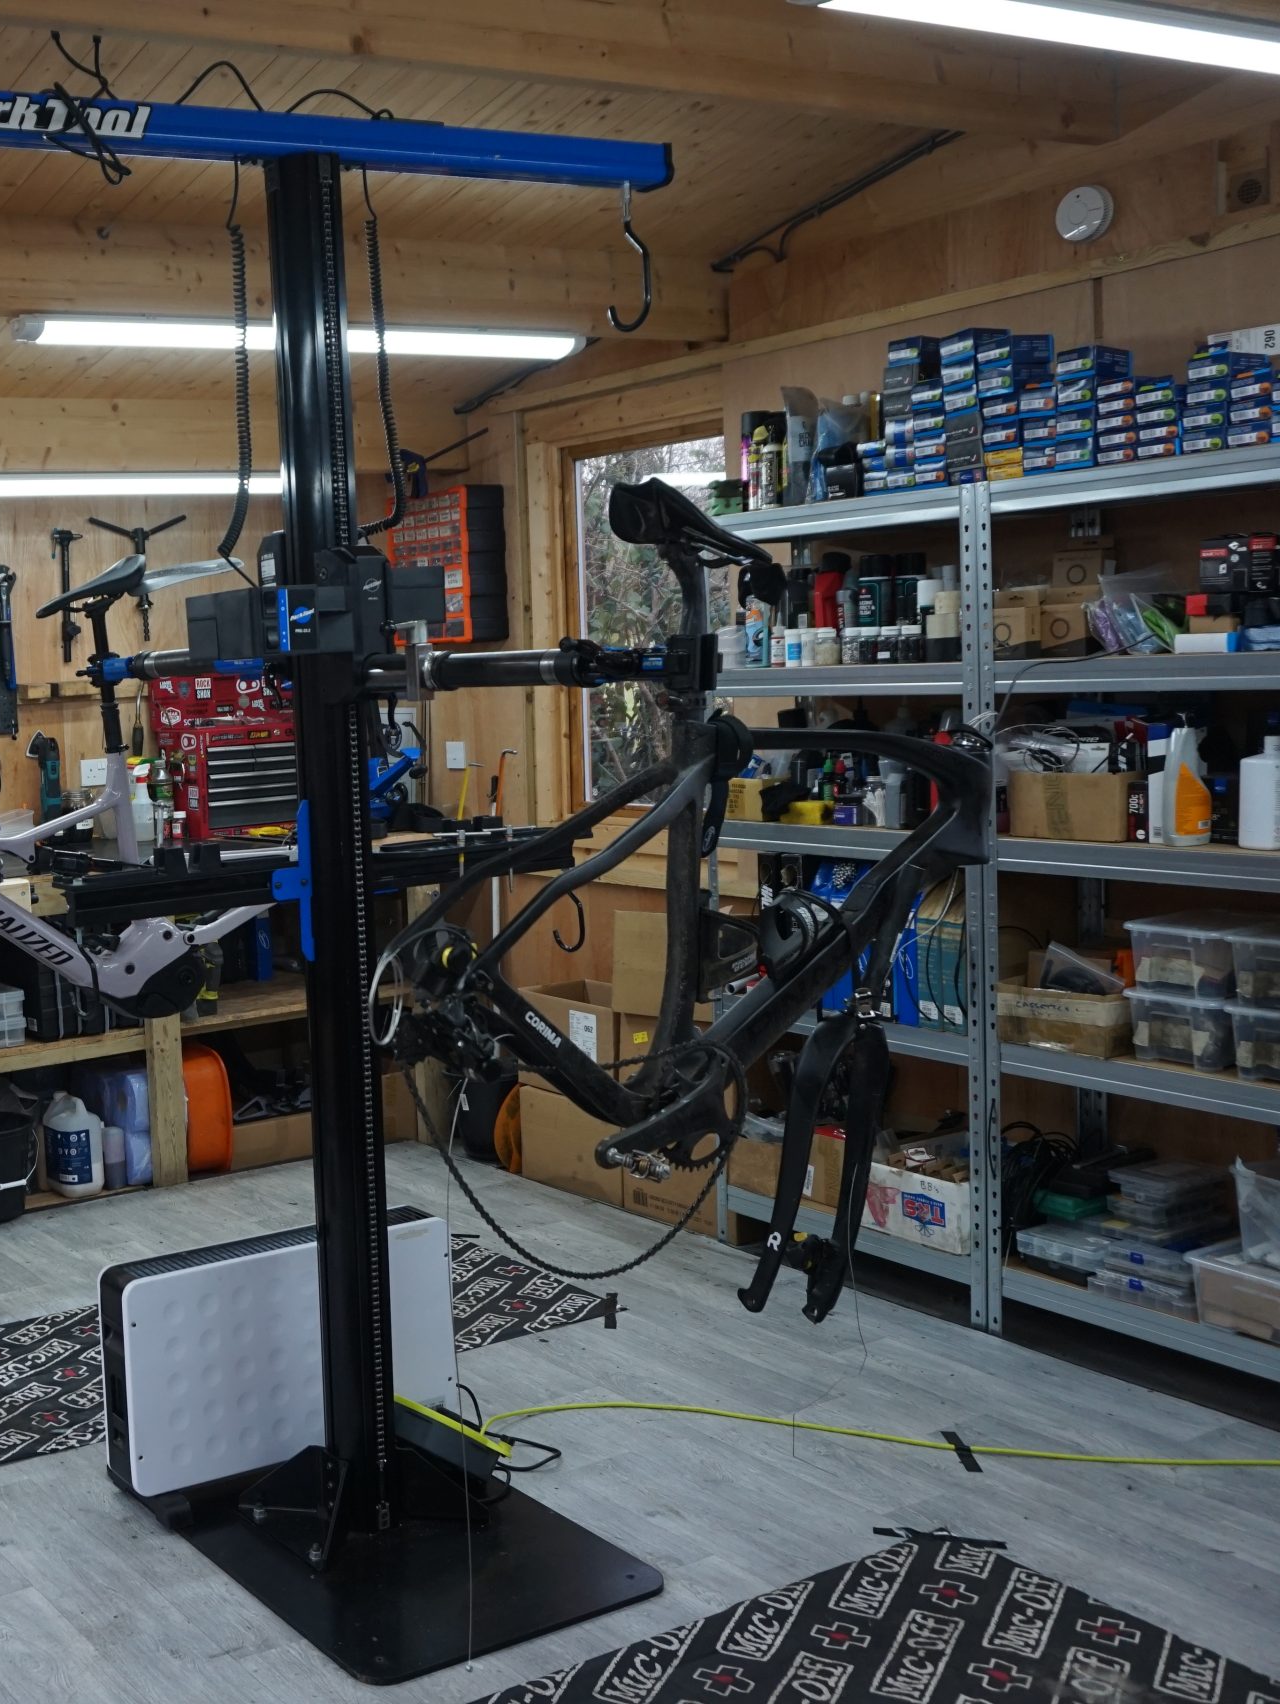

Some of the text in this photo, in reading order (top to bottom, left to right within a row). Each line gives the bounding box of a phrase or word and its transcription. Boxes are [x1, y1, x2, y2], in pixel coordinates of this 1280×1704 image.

[524, 1010, 562, 1049] CORIMA
[992, 1570, 1062, 1656] Muc-Off
[881, 1612, 957, 1701] Muc-Off
